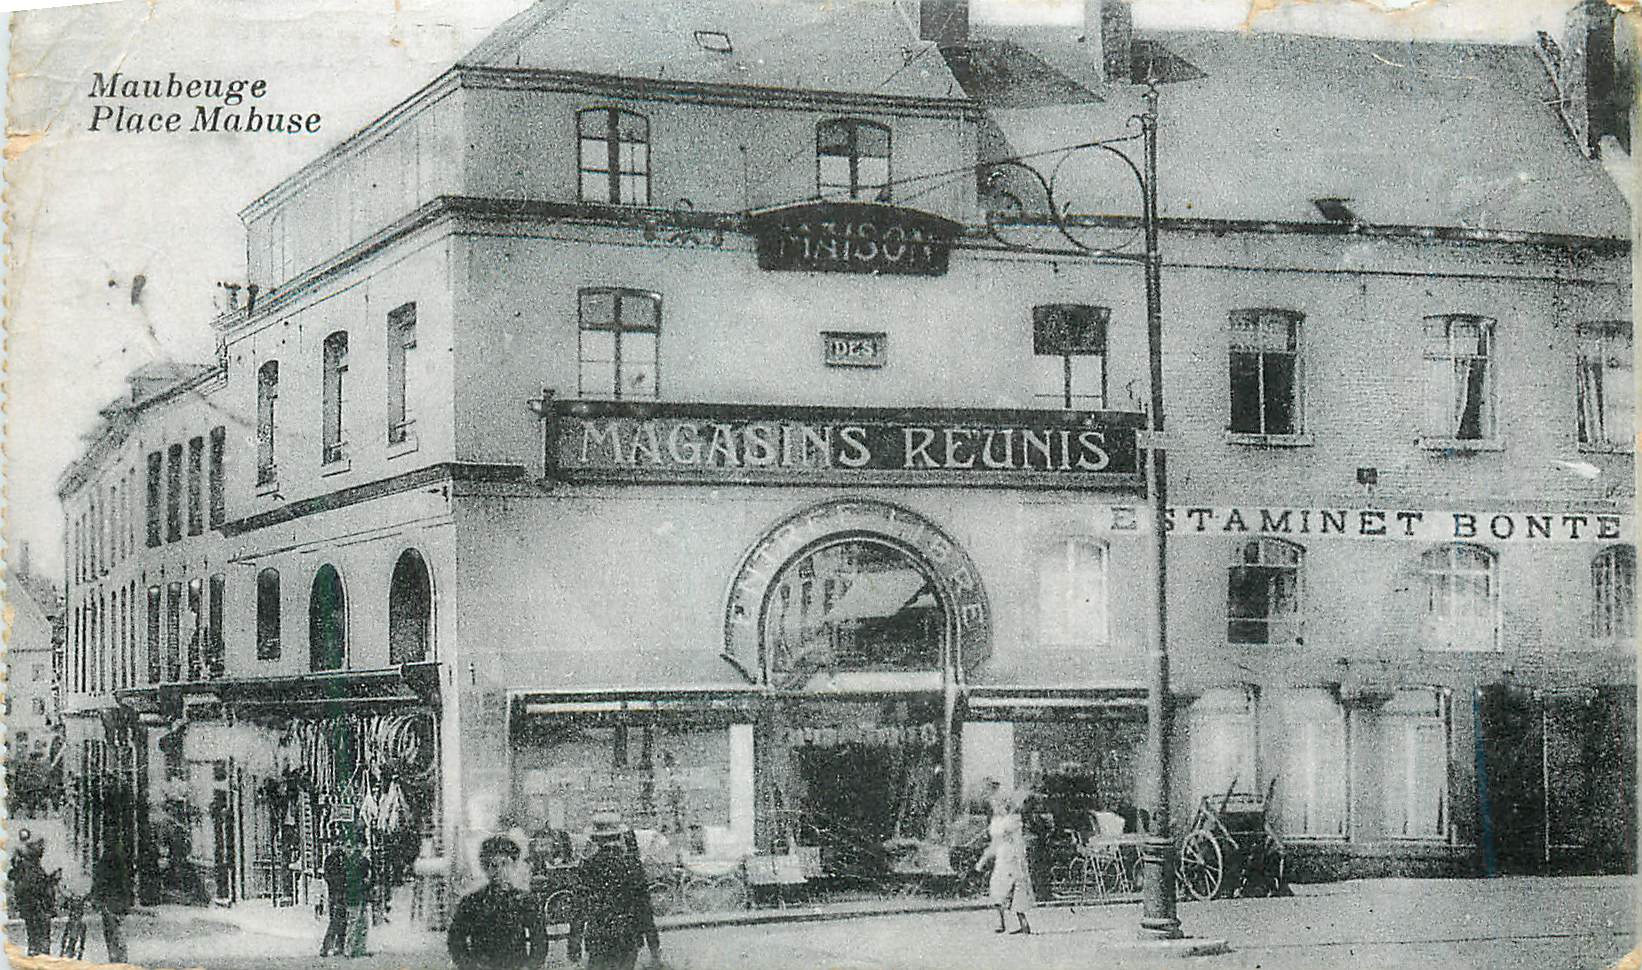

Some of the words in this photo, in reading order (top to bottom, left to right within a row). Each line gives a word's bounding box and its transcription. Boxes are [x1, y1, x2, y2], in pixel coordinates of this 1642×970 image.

[779, 221, 940, 263] MAISON
[834, 340, 874, 356] DES
[580, 421, 872, 468] MAGASINS
[1110, 508, 1424, 535] ESTAMINET
[1454, 513, 1621, 540] BONTE
